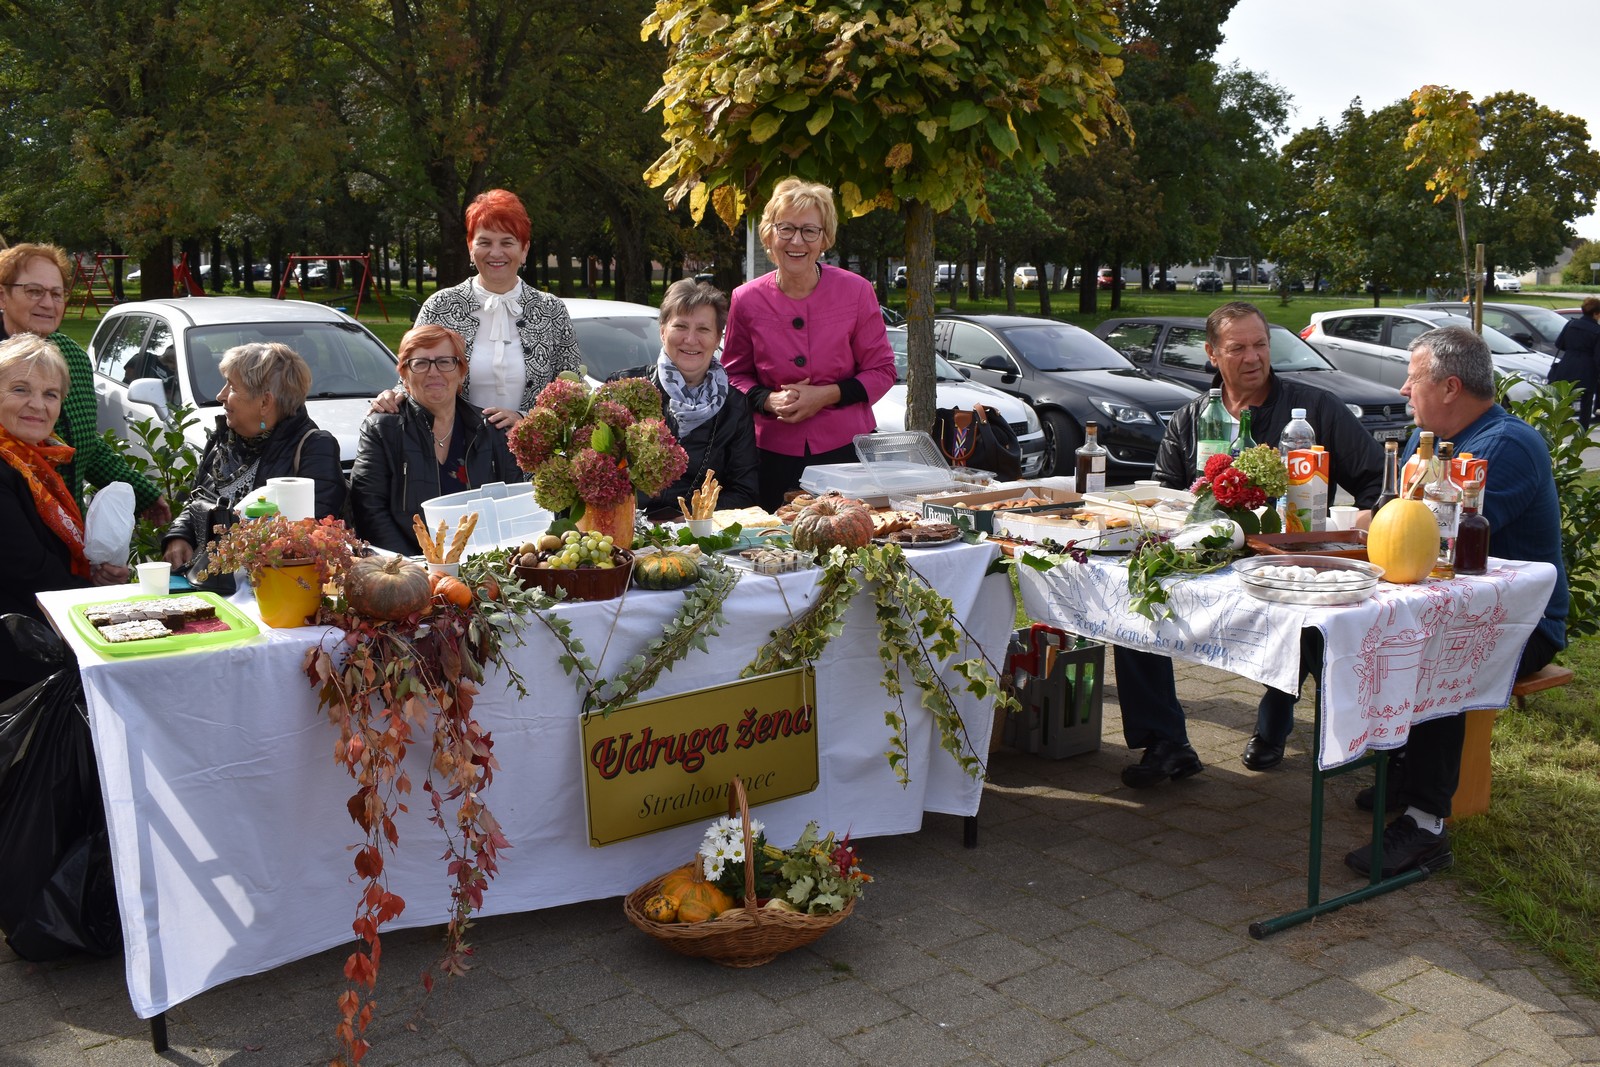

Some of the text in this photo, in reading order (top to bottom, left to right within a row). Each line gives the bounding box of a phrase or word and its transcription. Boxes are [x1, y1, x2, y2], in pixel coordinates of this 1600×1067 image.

[591, 704, 813, 780] Udruga žena
[638, 770, 776, 819] Strahonnec
